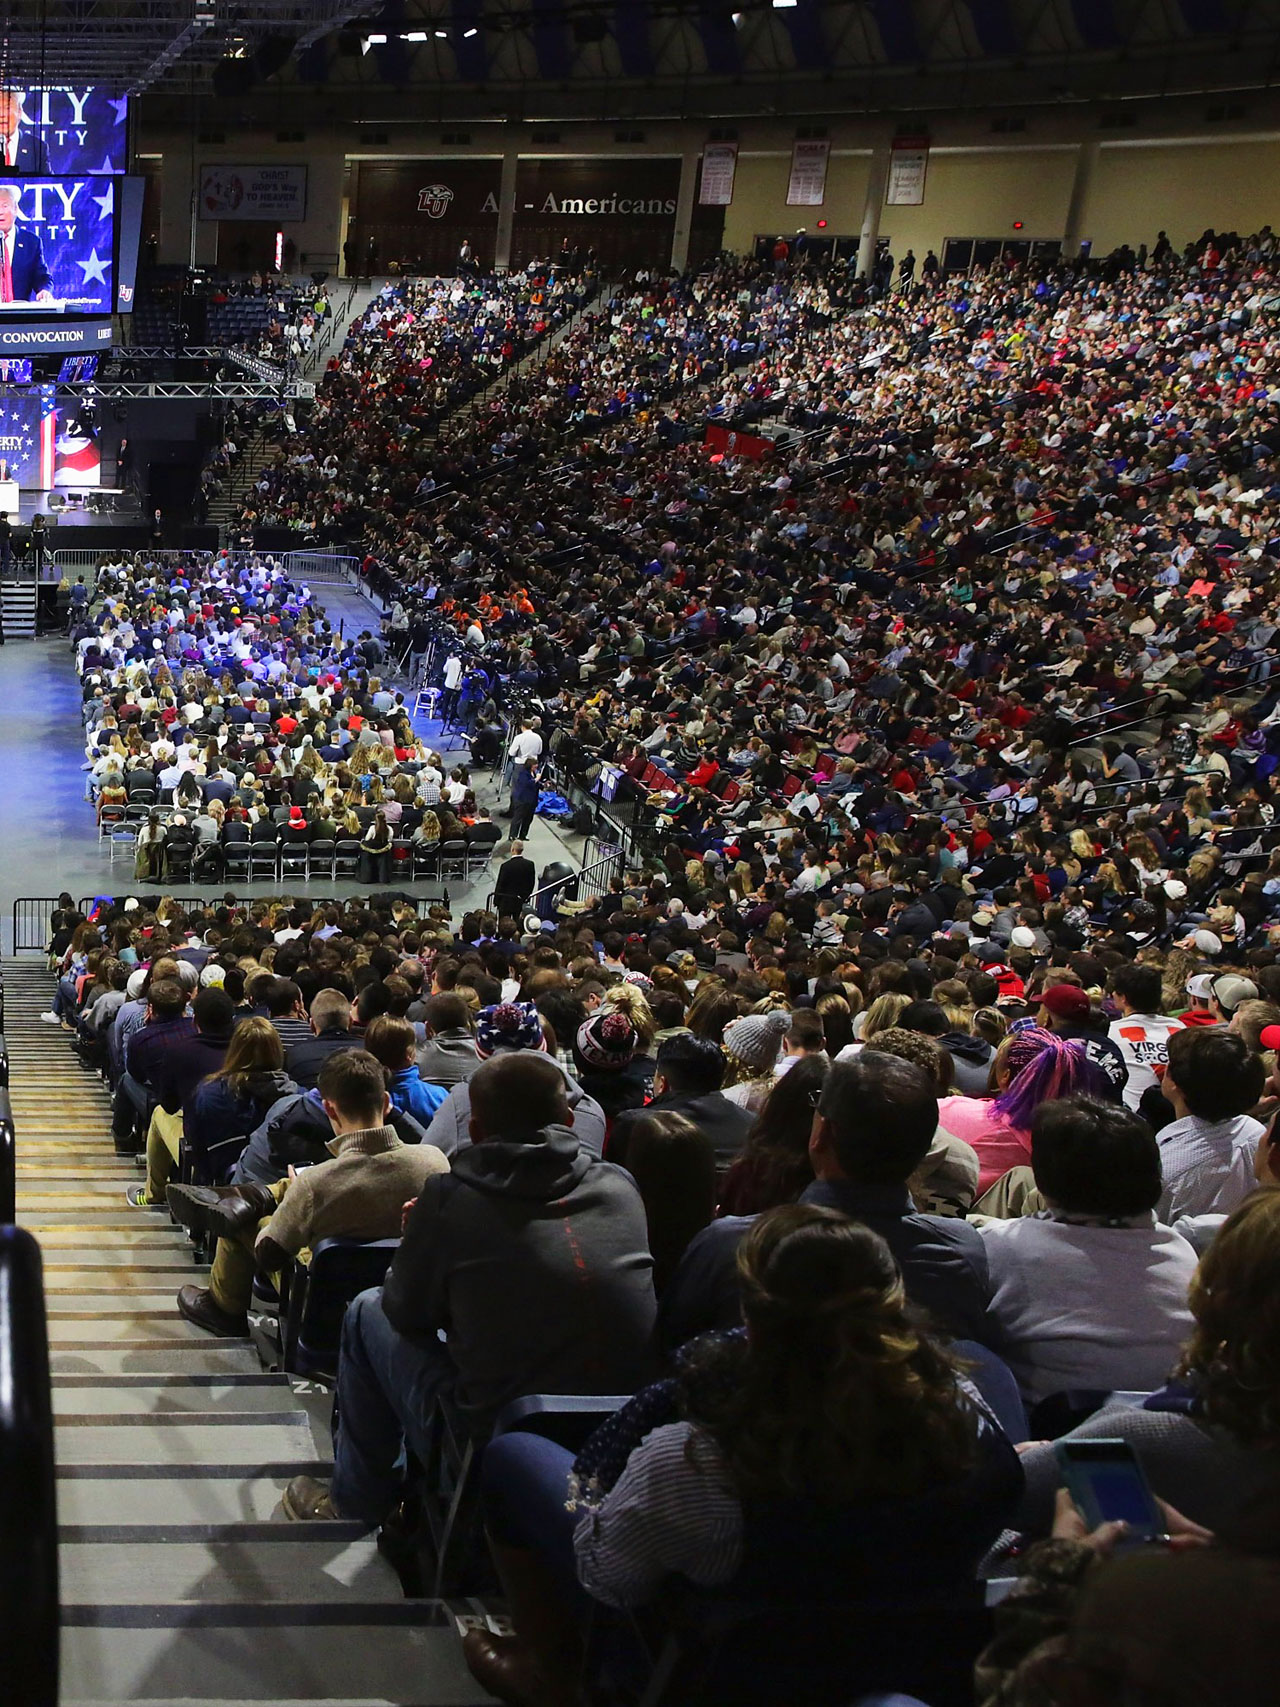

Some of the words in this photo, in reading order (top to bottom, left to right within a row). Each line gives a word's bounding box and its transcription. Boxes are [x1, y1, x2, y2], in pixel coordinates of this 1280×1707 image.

[246, 193, 258, 201] TO
[480, 191, 517, 213] Al
[539, 191, 676, 214] Americans
[3, 331, 84, 344] CONVOCATION
[64, 355, 96, 367] LIBETY
[1129, 1042, 1169, 1053] VIRG
